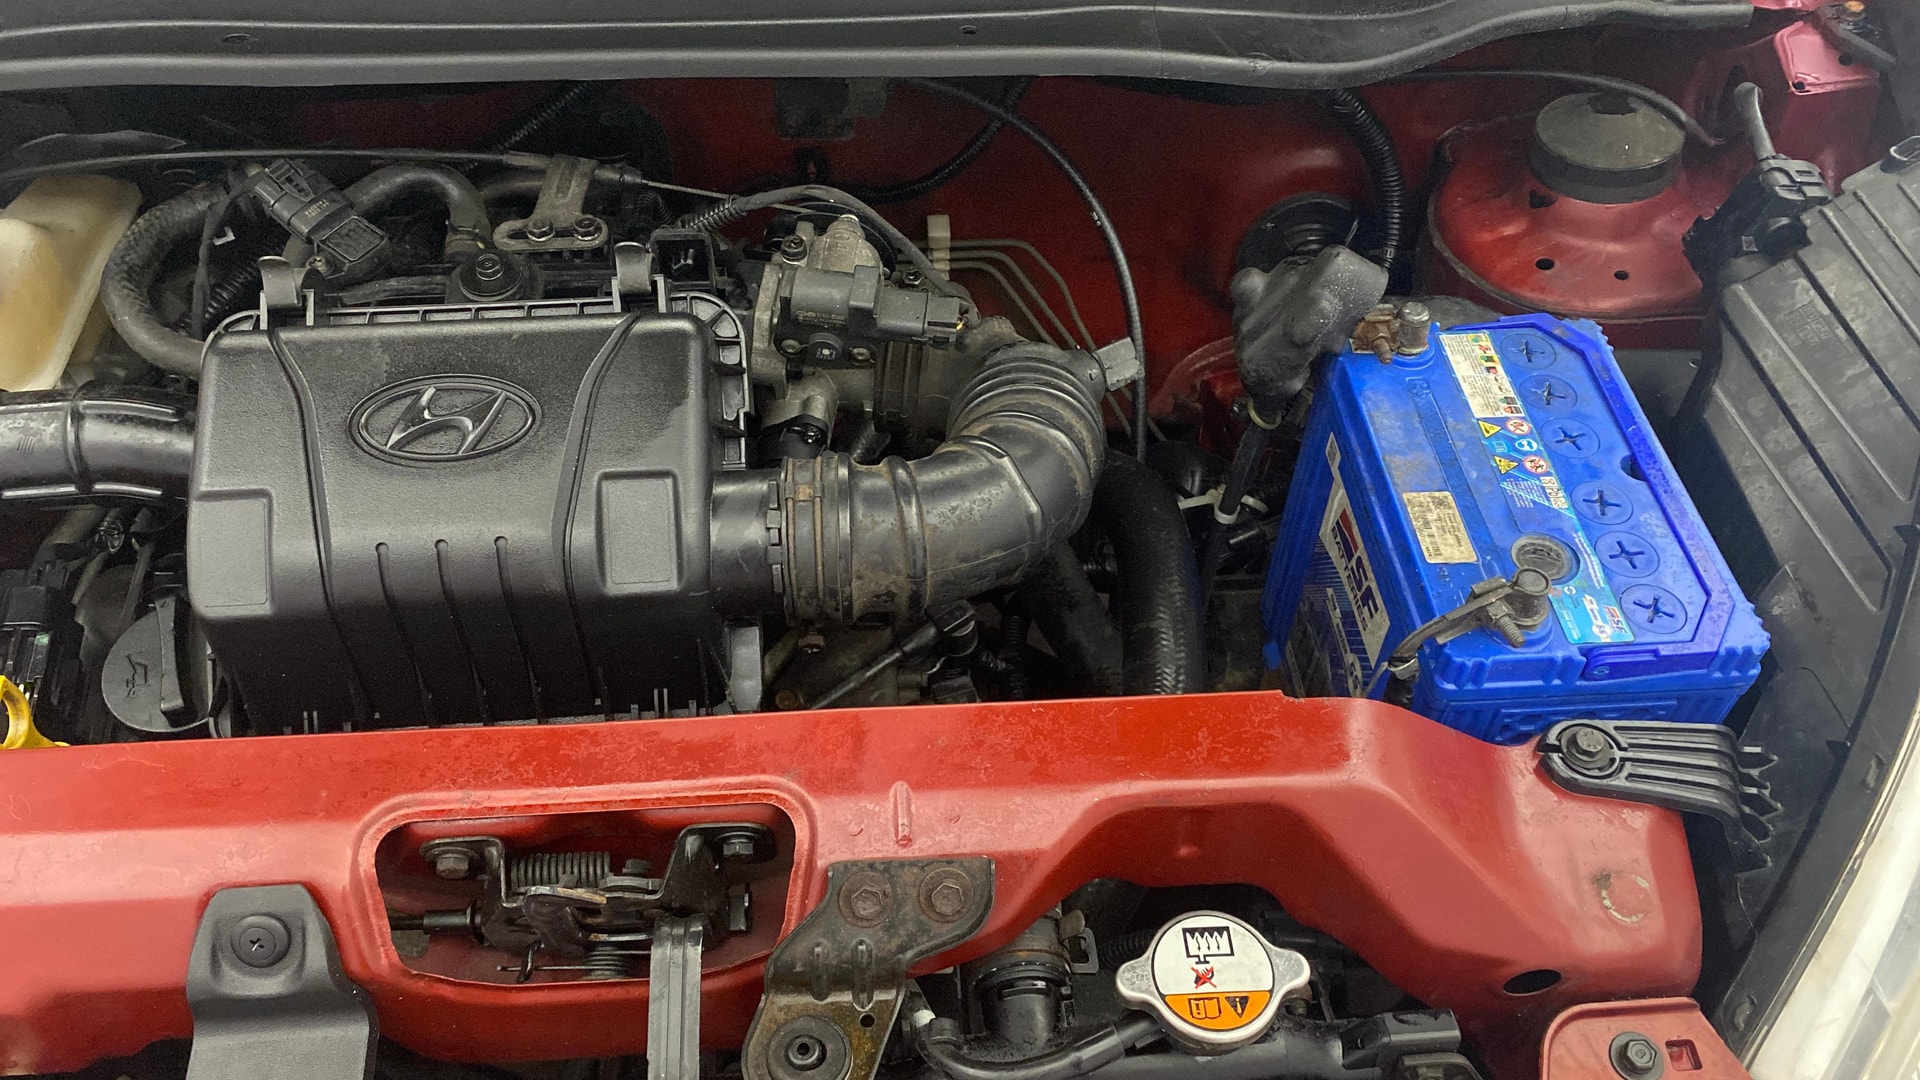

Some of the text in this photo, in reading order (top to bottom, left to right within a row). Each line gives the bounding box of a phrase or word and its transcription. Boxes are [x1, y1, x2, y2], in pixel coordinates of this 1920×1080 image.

[1331, 526, 1368, 632] BATTERIES
[1350, 556, 1379, 619] SF
[1612, 619, 1627, 635] SF
